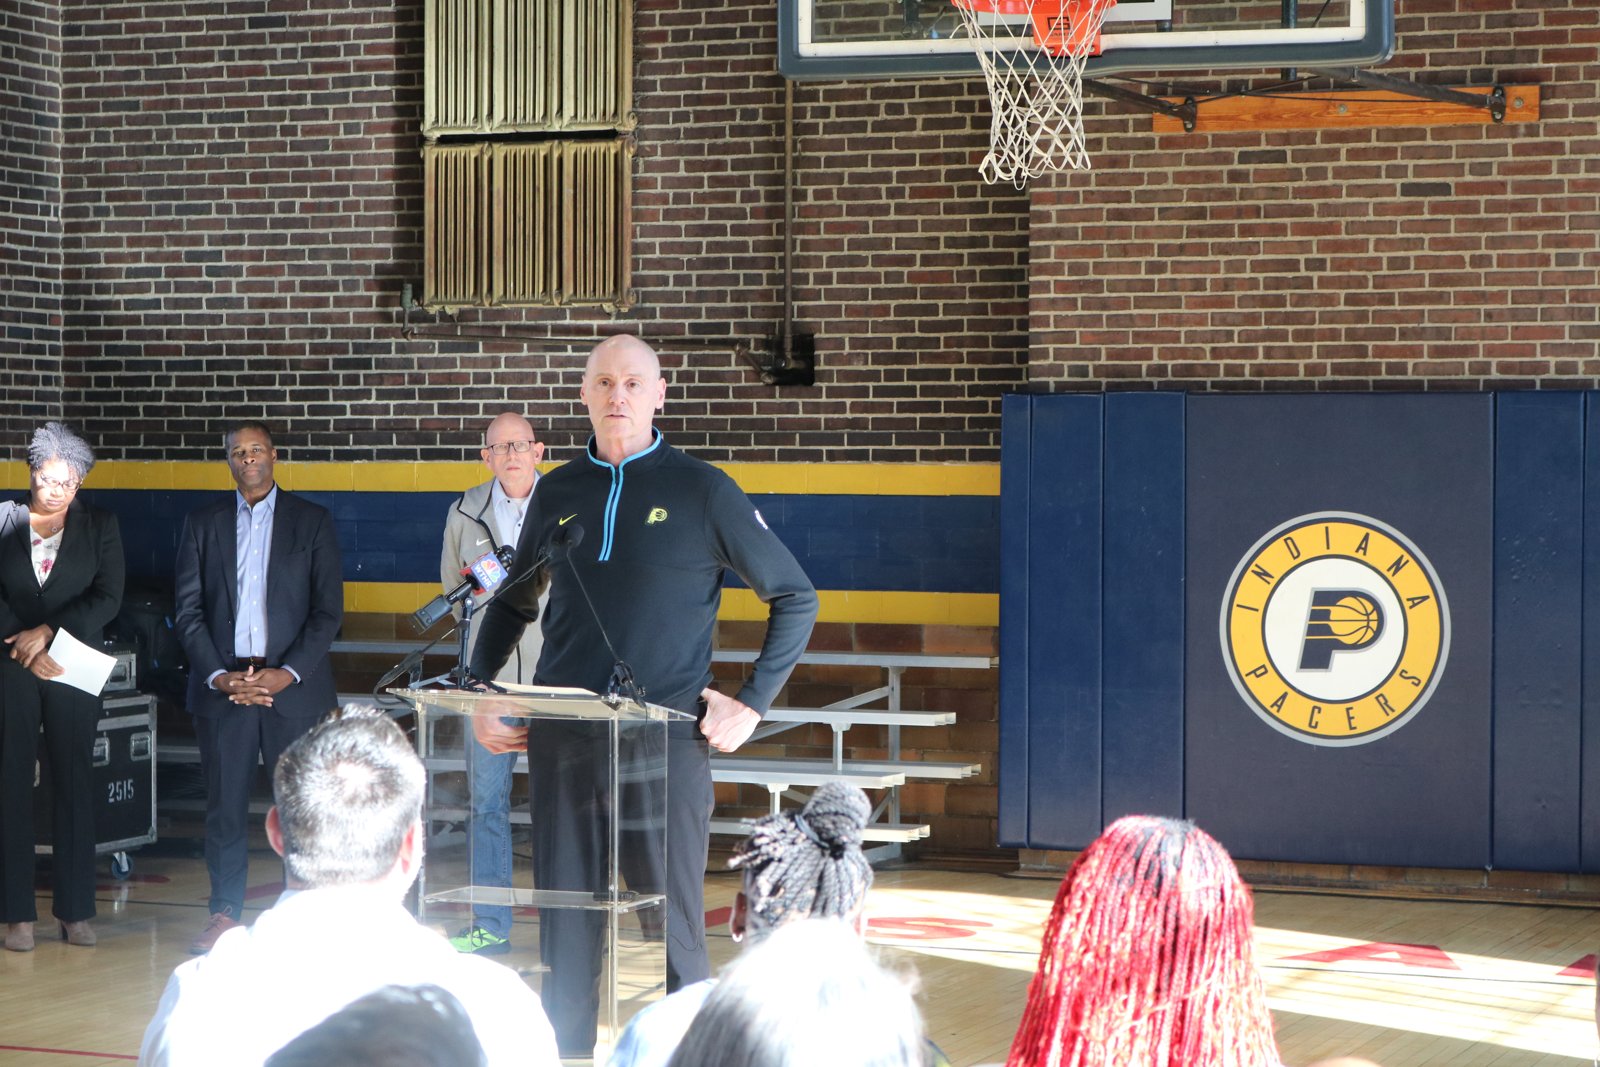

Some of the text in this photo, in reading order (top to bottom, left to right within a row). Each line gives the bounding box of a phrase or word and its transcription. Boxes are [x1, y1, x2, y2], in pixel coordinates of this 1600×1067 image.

[474, 564, 493, 588] WTHR
[1236, 526, 1430, 612] INDIANA
[1245, 664, 1421, 731] PACERS
[108, 779, 134, 803] 2515
